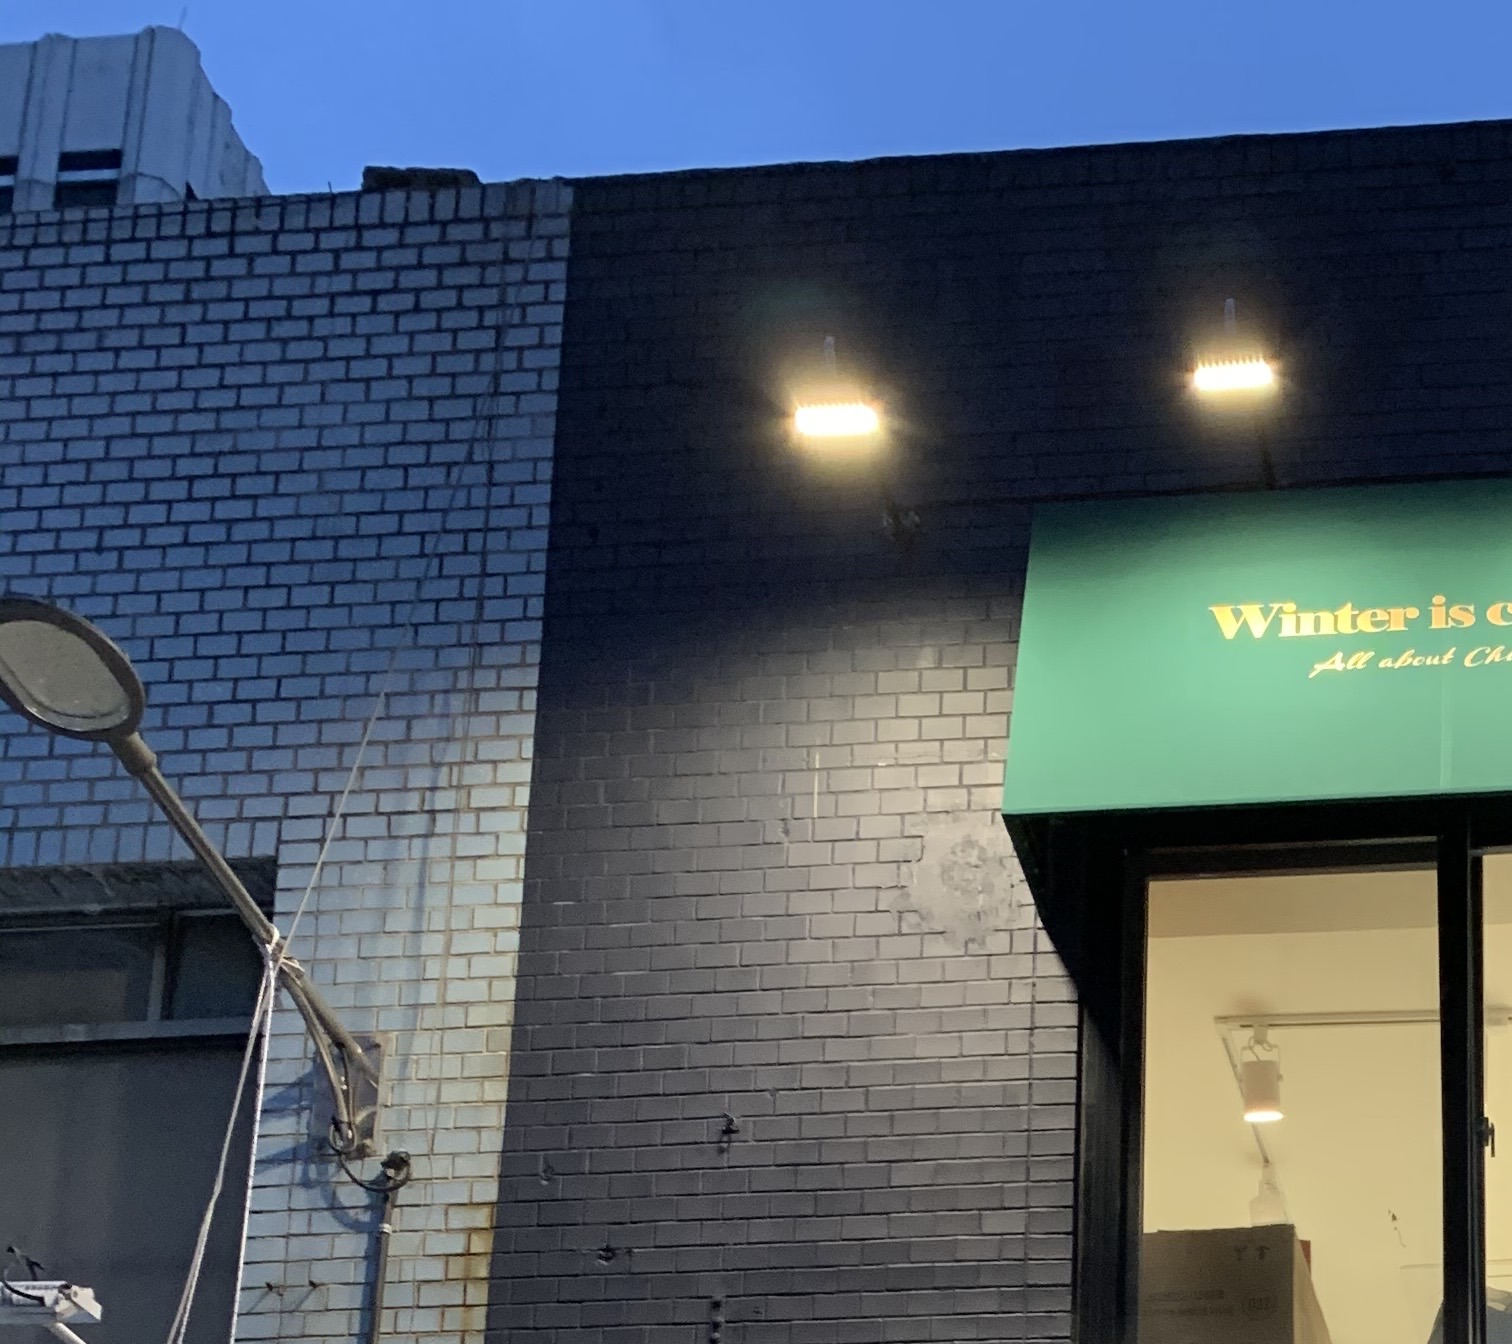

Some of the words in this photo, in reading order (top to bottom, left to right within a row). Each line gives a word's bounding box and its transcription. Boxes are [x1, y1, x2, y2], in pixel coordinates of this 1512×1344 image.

[1210, 600, 1421, 641] Winter
[1430, 593, 1476, 630] is
[1309, 650, 1372, 678] All
[1379, 647, 1456, 669] about
